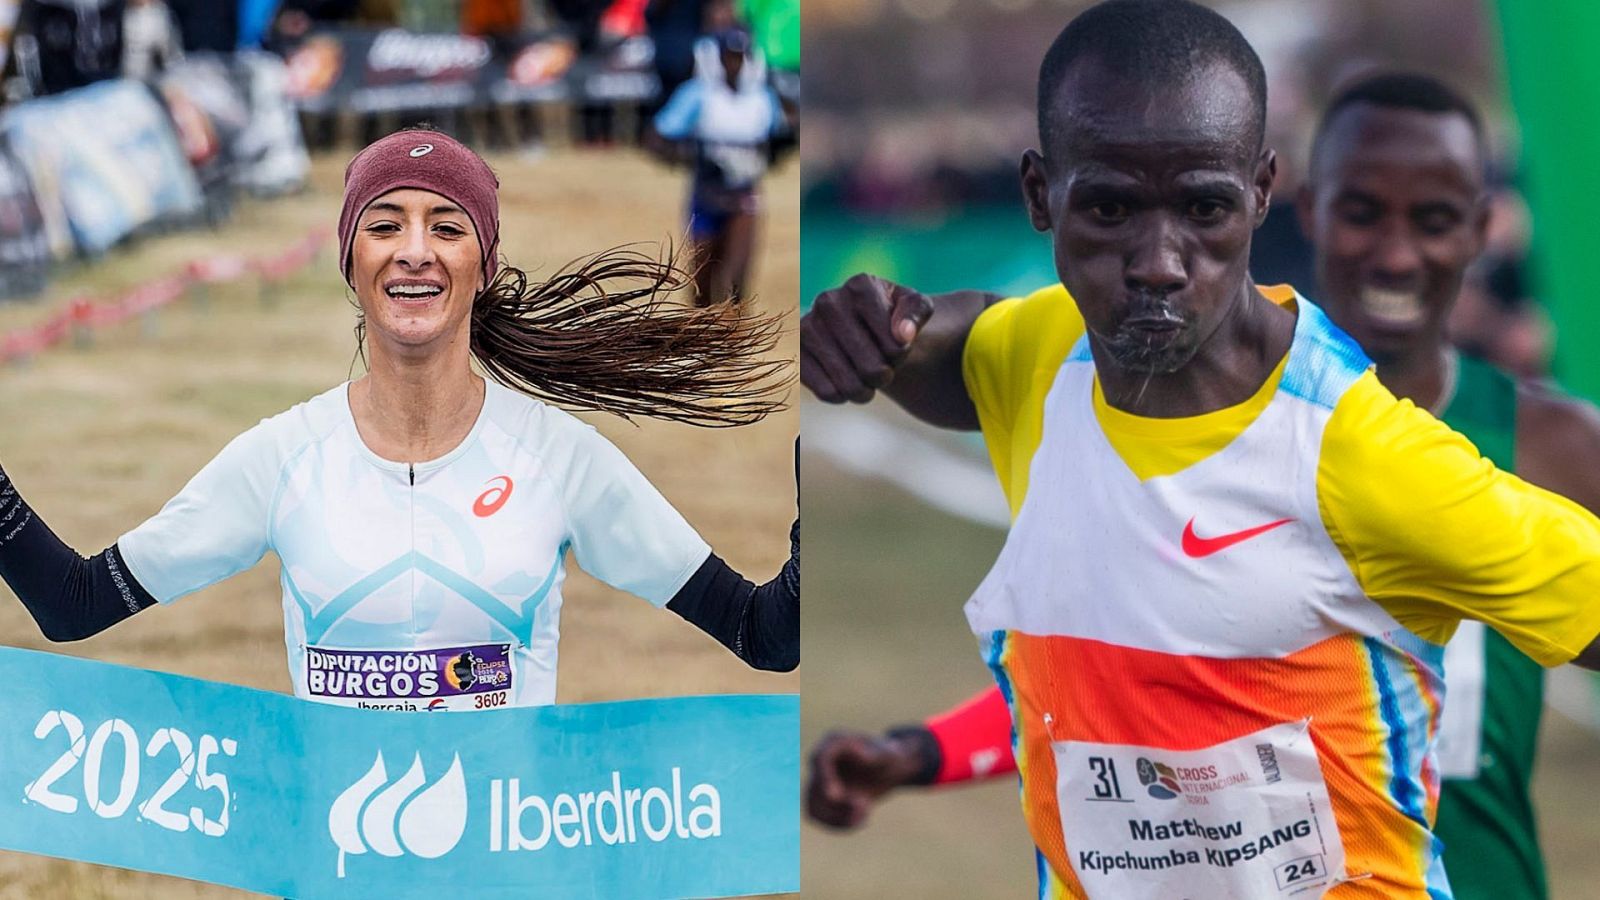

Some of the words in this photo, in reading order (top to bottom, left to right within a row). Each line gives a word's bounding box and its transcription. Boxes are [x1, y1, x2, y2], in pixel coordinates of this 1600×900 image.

[308, 651, 437, 673] DIPUTACIÓN
[309, 670, 439, 697] BURGOS
[474, 691, 507, 709] 3602
[22, 708, 238, 837] 2025
[1088, 757, 1122, 799] 31
[1176, 765, 1218, 781] CROSS
[489, 767, 722, 853] Iberdrola
[1128, 819, 1242, 841] Matthew
[1080, 848, 1200, 875] Kipchumba
[1206, 819, 1312, 868] KIPSANG
[1284, 859, 1317, 883] 24
